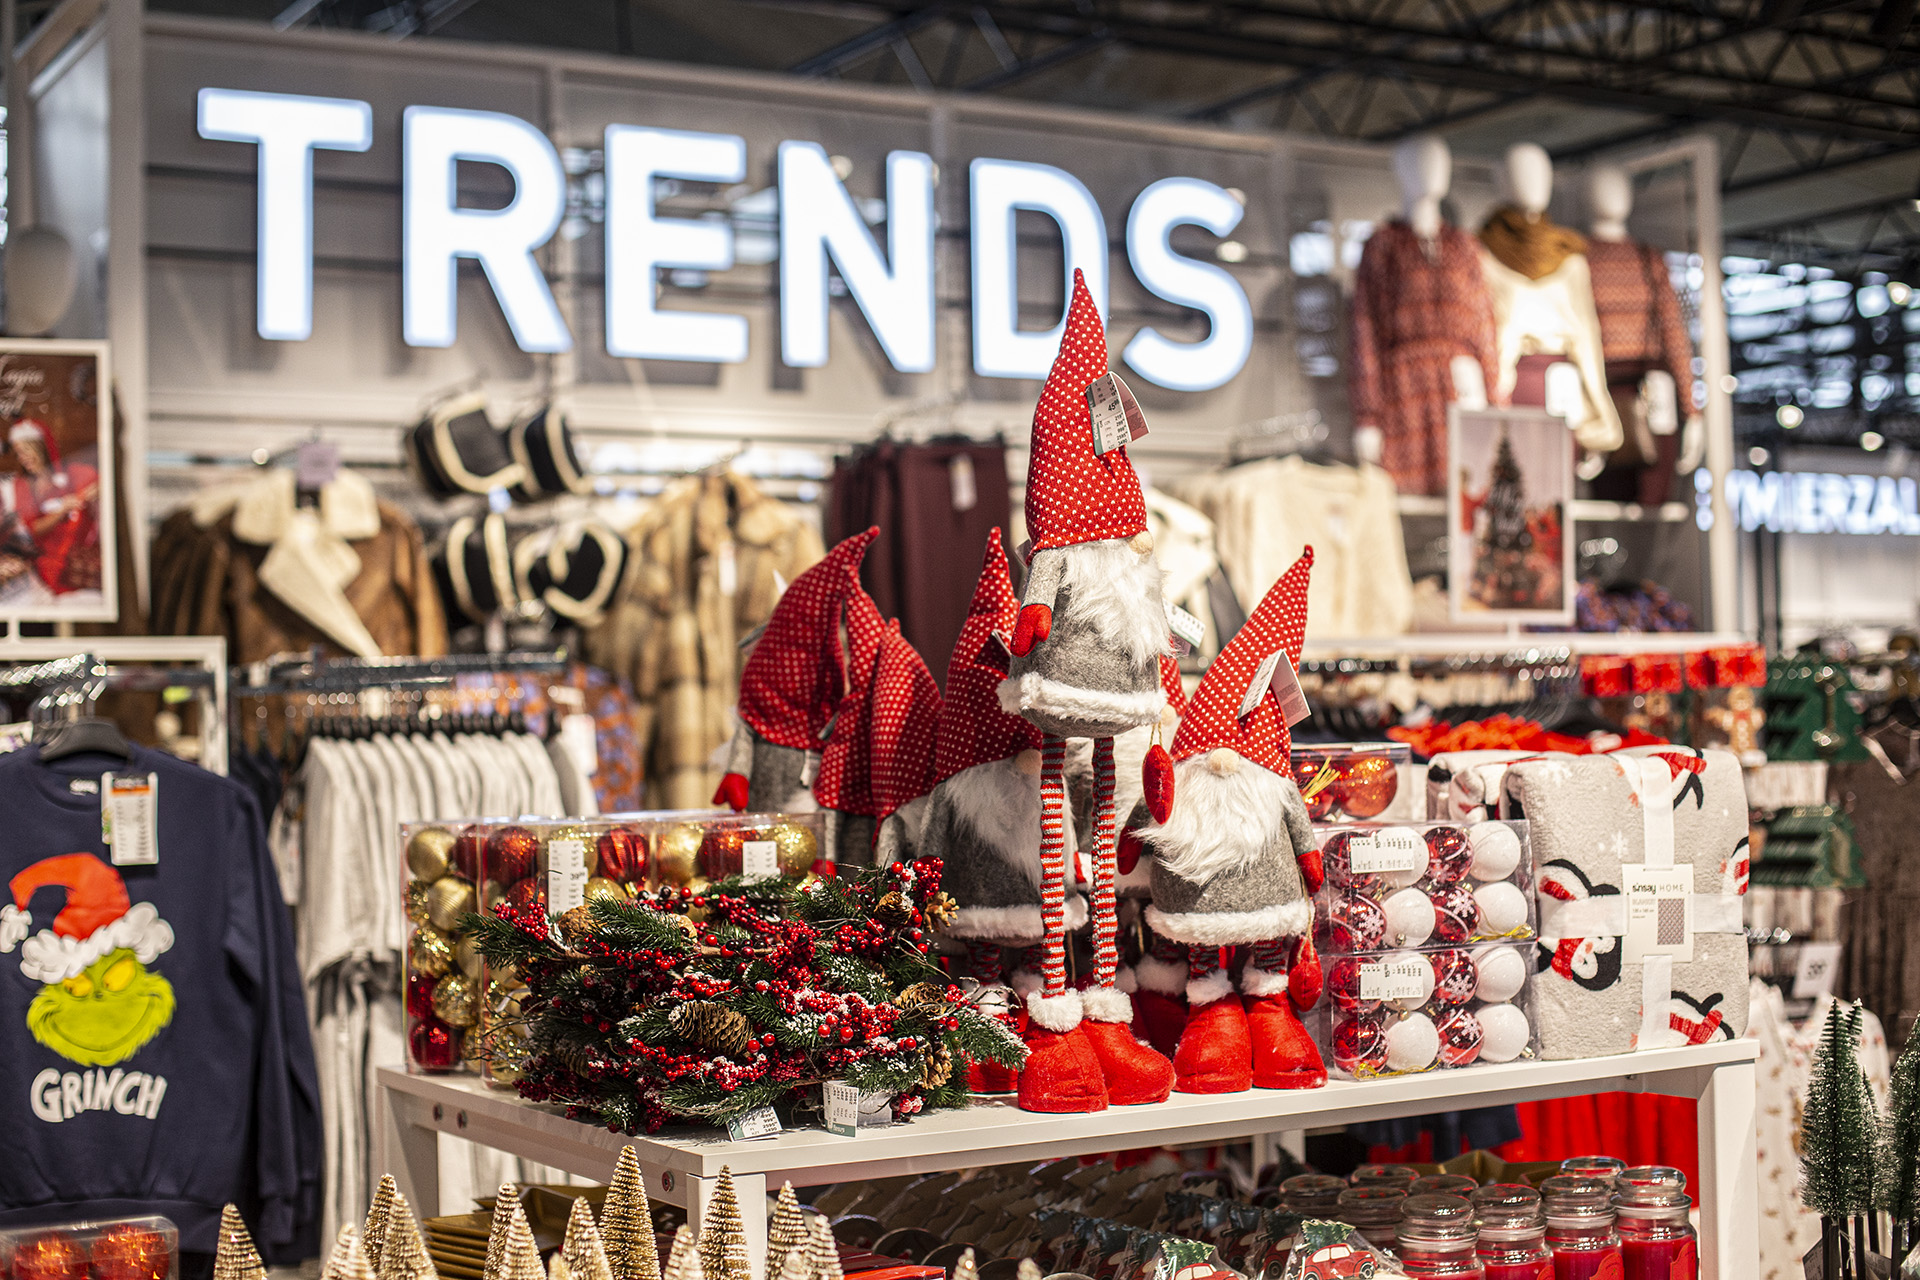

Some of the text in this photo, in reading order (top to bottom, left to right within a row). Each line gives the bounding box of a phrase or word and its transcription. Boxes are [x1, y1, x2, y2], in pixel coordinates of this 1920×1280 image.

[196, 87, 1254, 391] TRENDS
[1632, 882, 1684, 895] sinsay HOME
[30, 1067, 168, 1123] GRINCH
